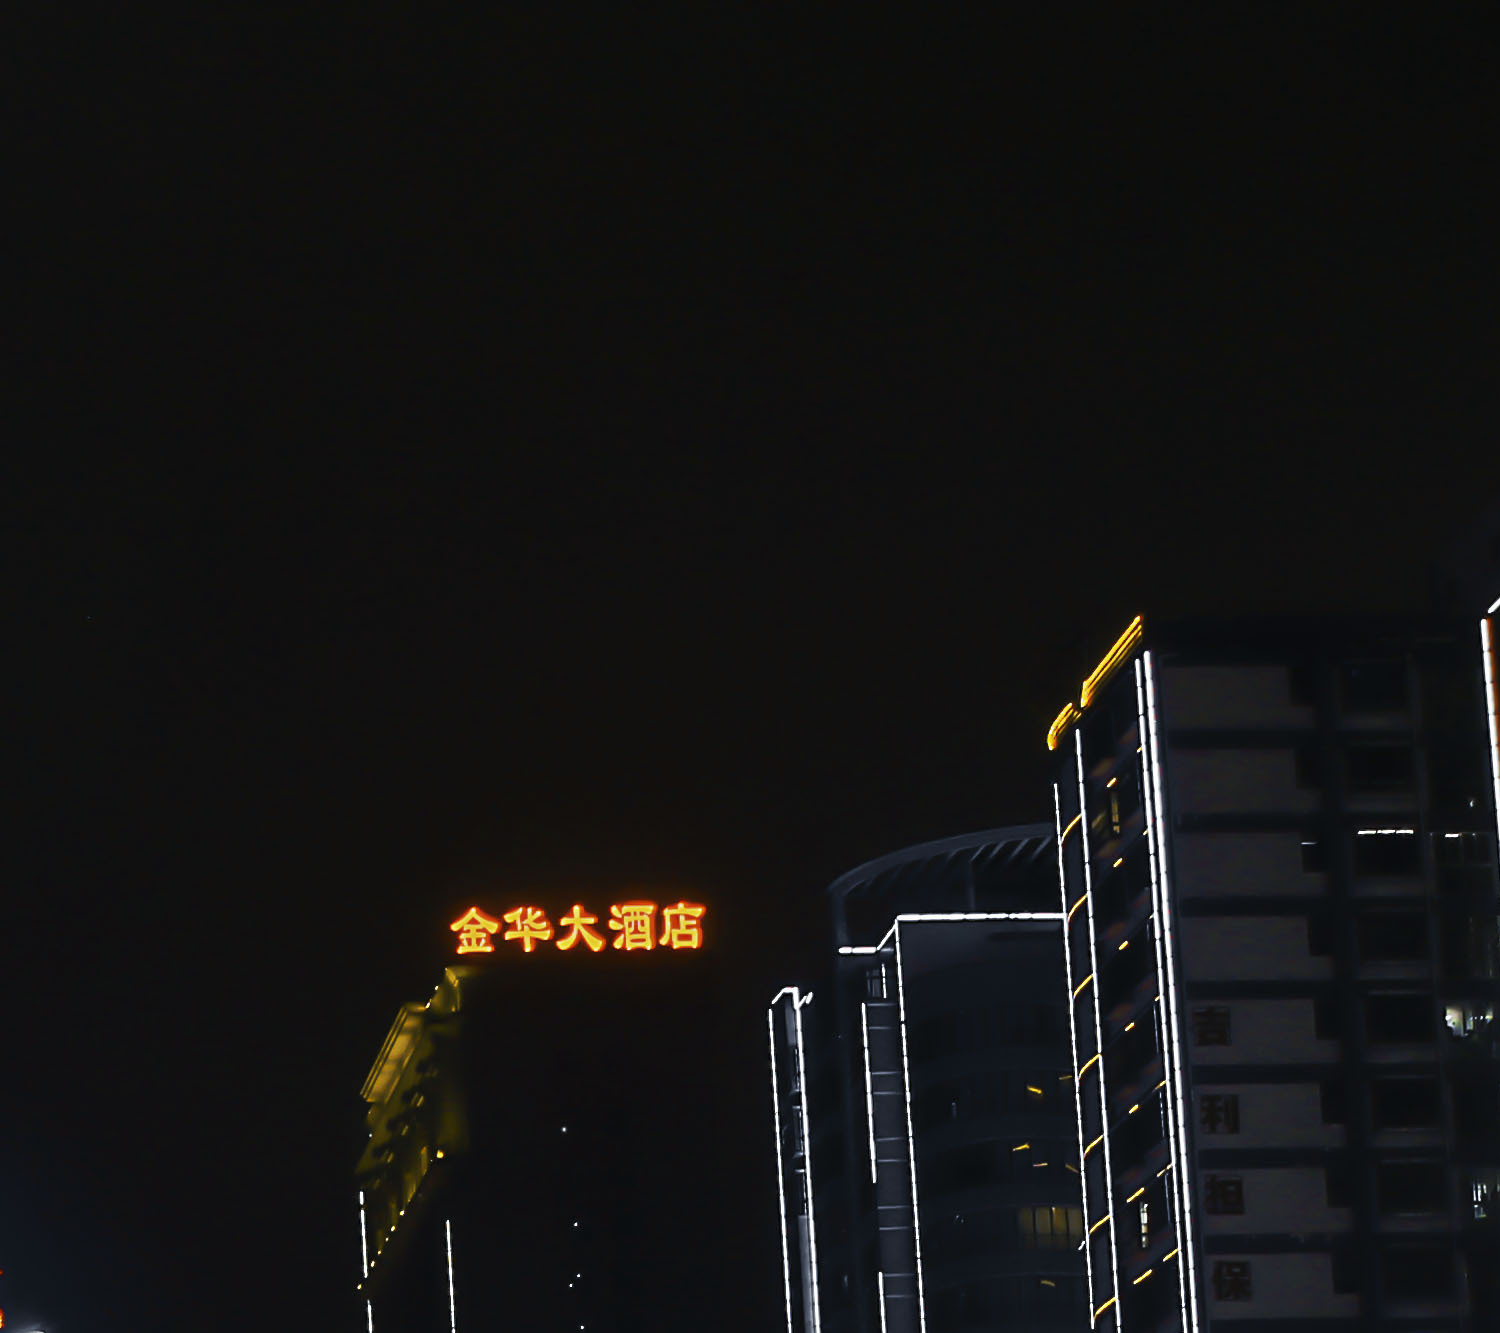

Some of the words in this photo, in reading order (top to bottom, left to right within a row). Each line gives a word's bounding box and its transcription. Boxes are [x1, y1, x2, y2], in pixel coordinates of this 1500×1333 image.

[450, 901, 706, 954] 金华大酒店
